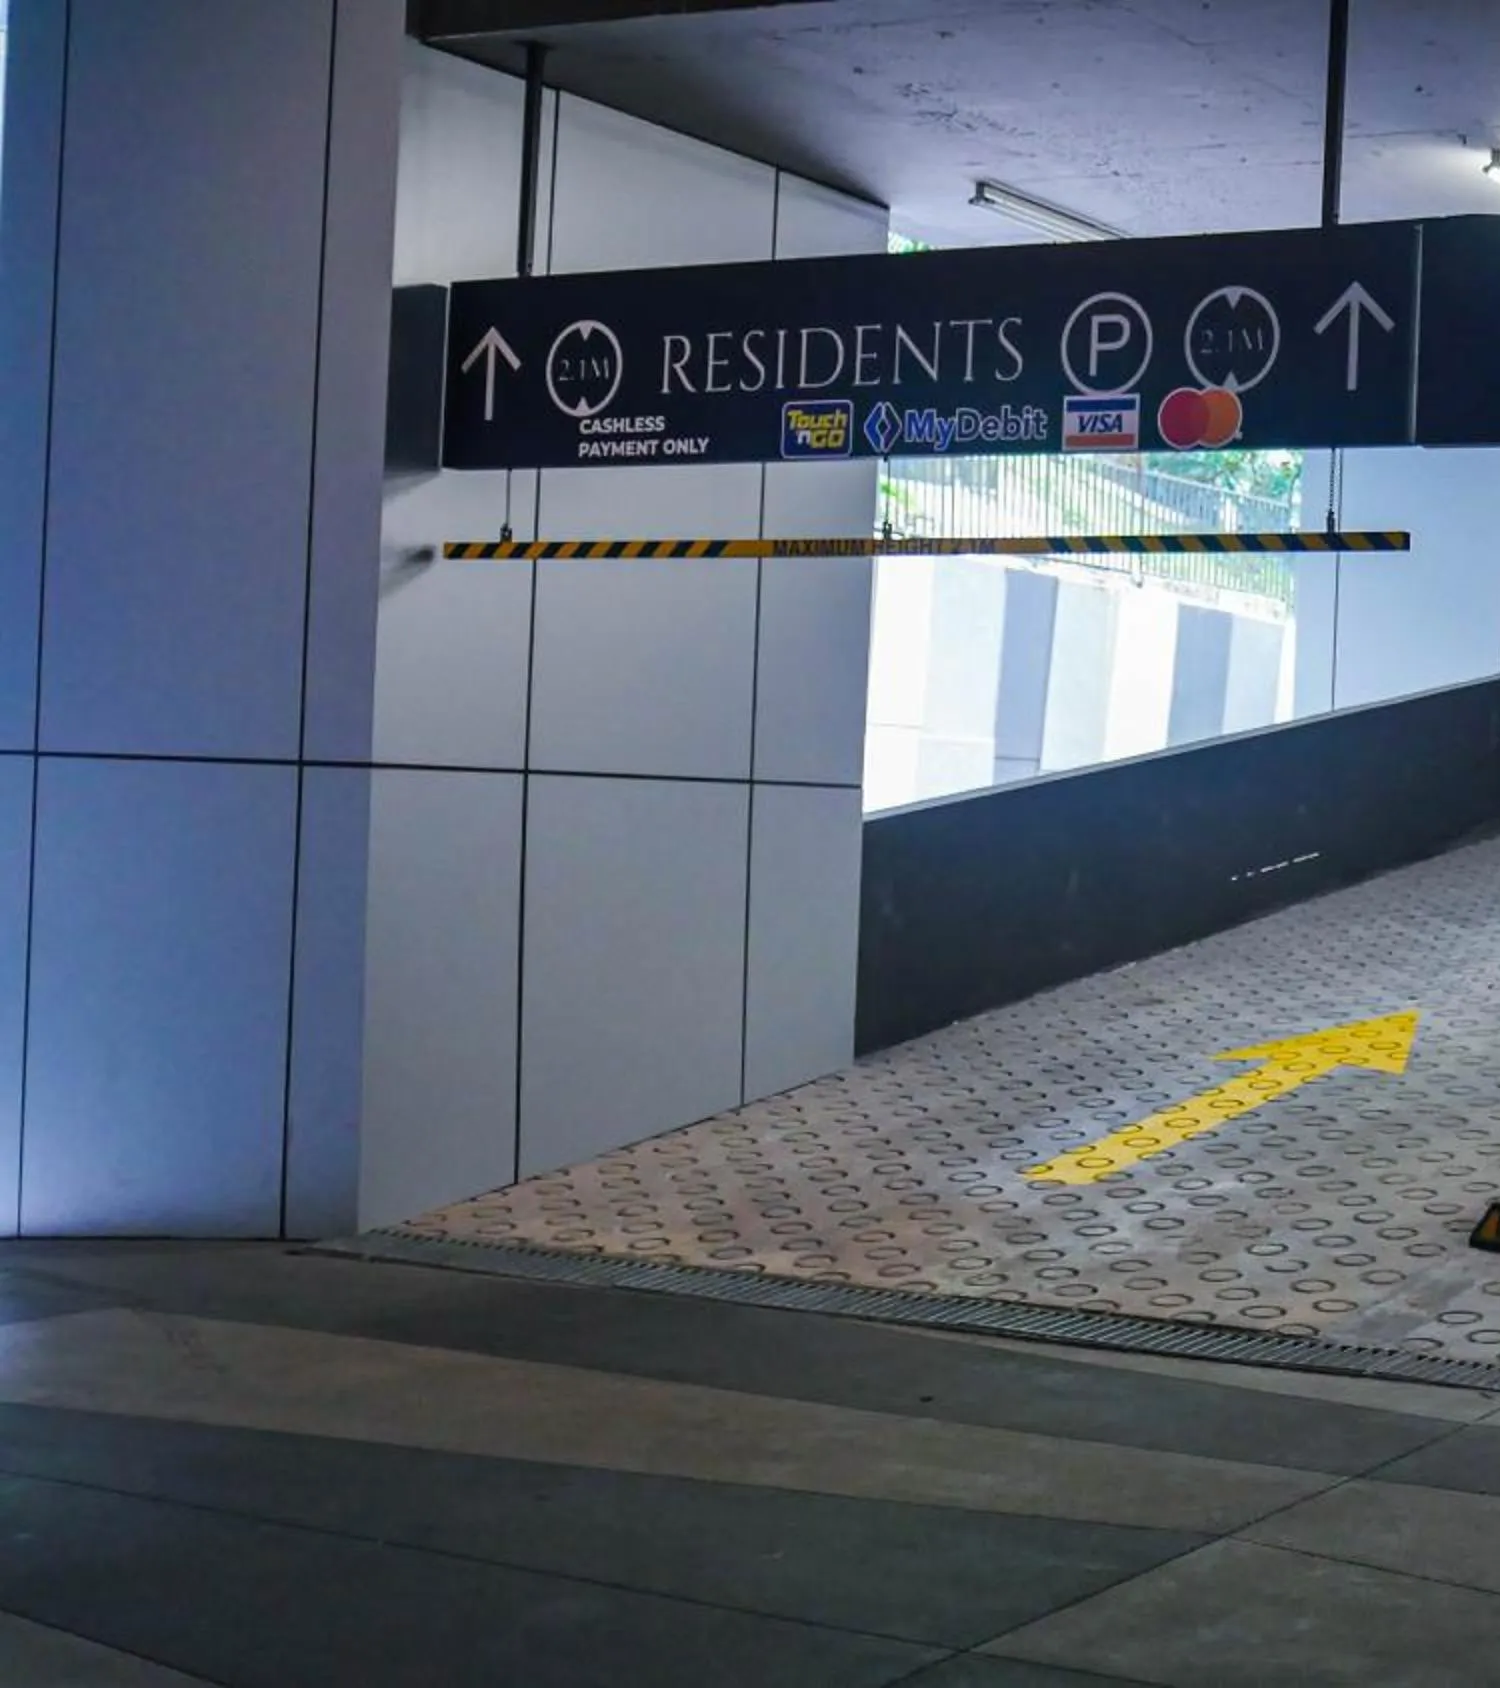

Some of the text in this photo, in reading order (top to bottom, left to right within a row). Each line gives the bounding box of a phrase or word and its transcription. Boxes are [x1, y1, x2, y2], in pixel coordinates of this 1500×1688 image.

[558, 318, 1024, 394] 2.1M RESIDENTS
[1089, 314, 1131, 377] P
[579, 416, 665, 434] CASHLESS
[788, 409, 847, 430] Touch
[904, 404, 1048, 451] MyDebit
[1078, 413, 1123, 433] VISA
[578, 437, 709, 458] PAYMENT ONLY
[773, 539, 865, 557] MAXIMUM
[873, 538, 944, 556] HEIGHT
